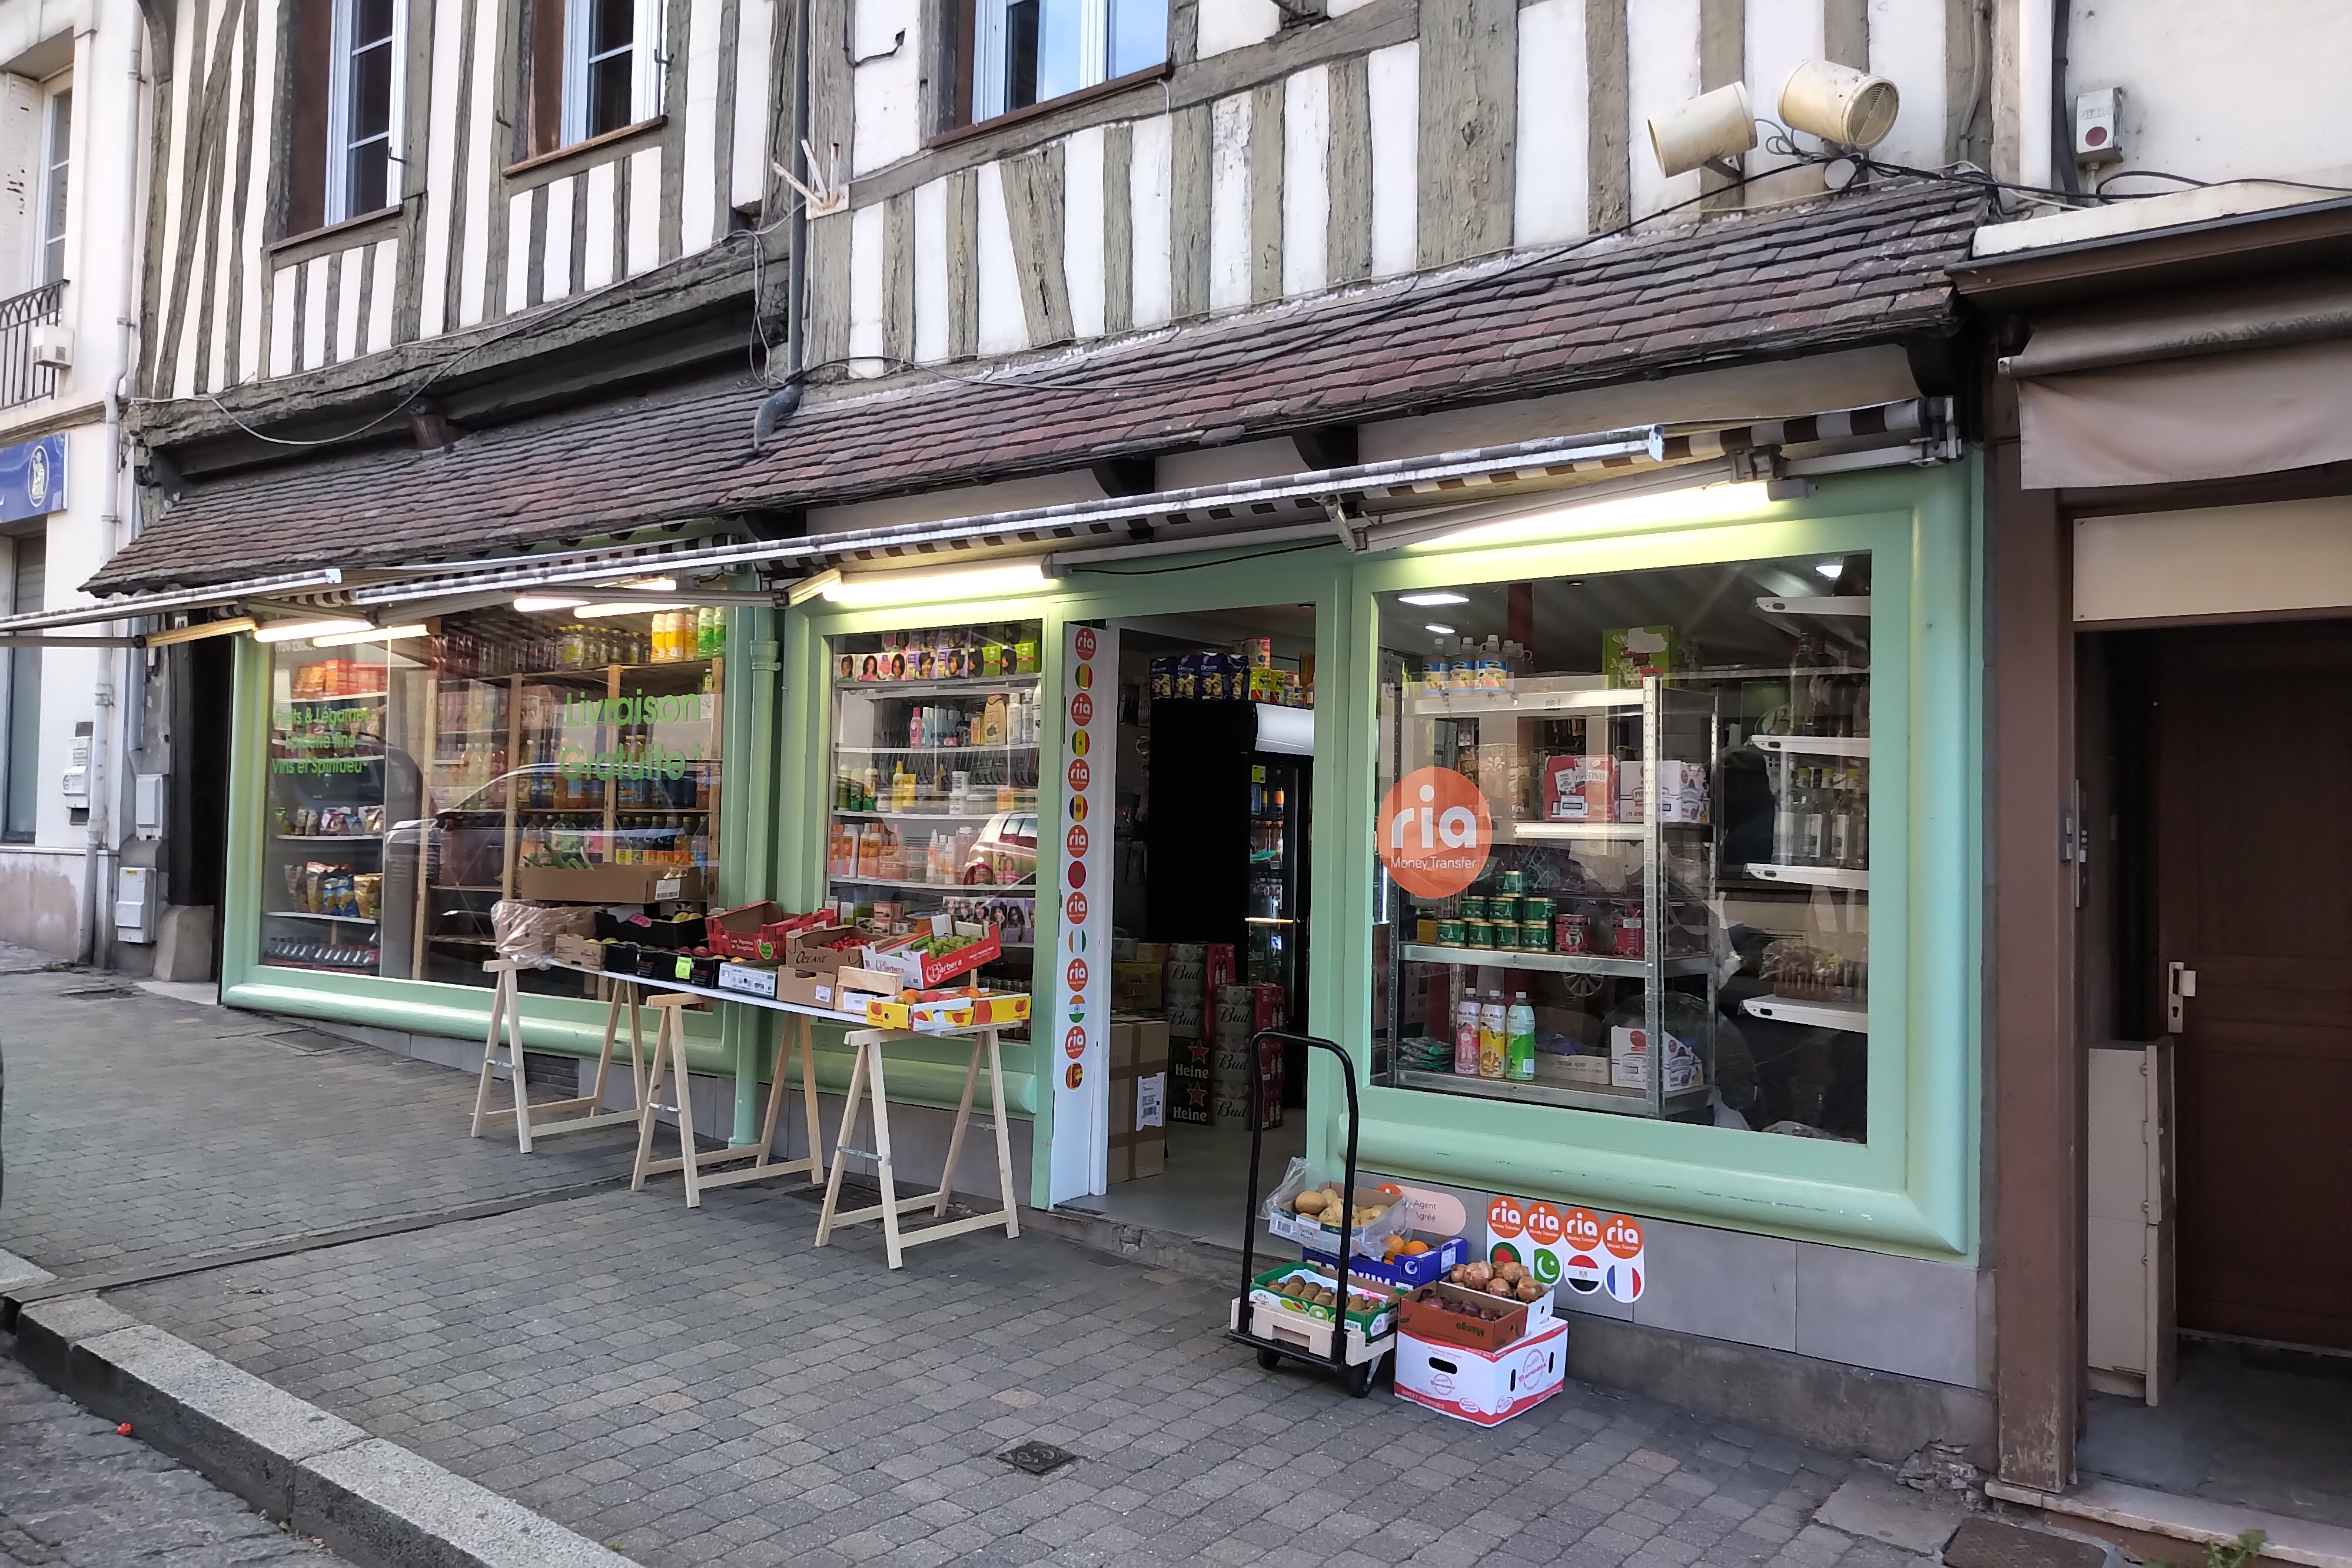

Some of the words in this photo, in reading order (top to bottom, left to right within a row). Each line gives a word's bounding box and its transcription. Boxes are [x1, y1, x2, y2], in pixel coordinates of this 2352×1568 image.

[1078, 632, 1094, 649] ria
[565, 688, 700, 727] Livraison
[1074, 697, 1090, 714] ria
[305, 707, 313, 723] &
[272, 758, 294, 774] Vins
[297, 759, 308, 774] et
[1071, 762, 1088, 779] ria
[1391, 784, 1477, 849] ria
[1069, 829, 1086, 846] ria
[1390, 857, 1428, 872] Money
[1430, 856, 1476, 869] Transfer
[1068, 895, 1085, 912] ria
[1069, 962, 1086, 979] ria
[1171, 964, 1201, 980] Bud
[1169, 1009, 1199, 1026] Bud
[1219, 1006, 1250, 1023] Bud
[1067, 1029, 1084, 1047] ria
[1218, 1053, 1248, 1071] Bud
[1175, 1063, 1209, 1079] Heine
[1173, 1106, 1207, 1122] Heine
[1217, 1100, 1247, 1118] Bud
[1414, 1200, 1436, 1211] Agent
[1491, 1201, 1521, 1225] ria
[1529, 1207, 1559, 1231] ria
[1567, 1212, 1597, 1237] ria
[1607, 1220, 1639, 1244] ria
[1456, 1322, 1484, 1337] Mango
